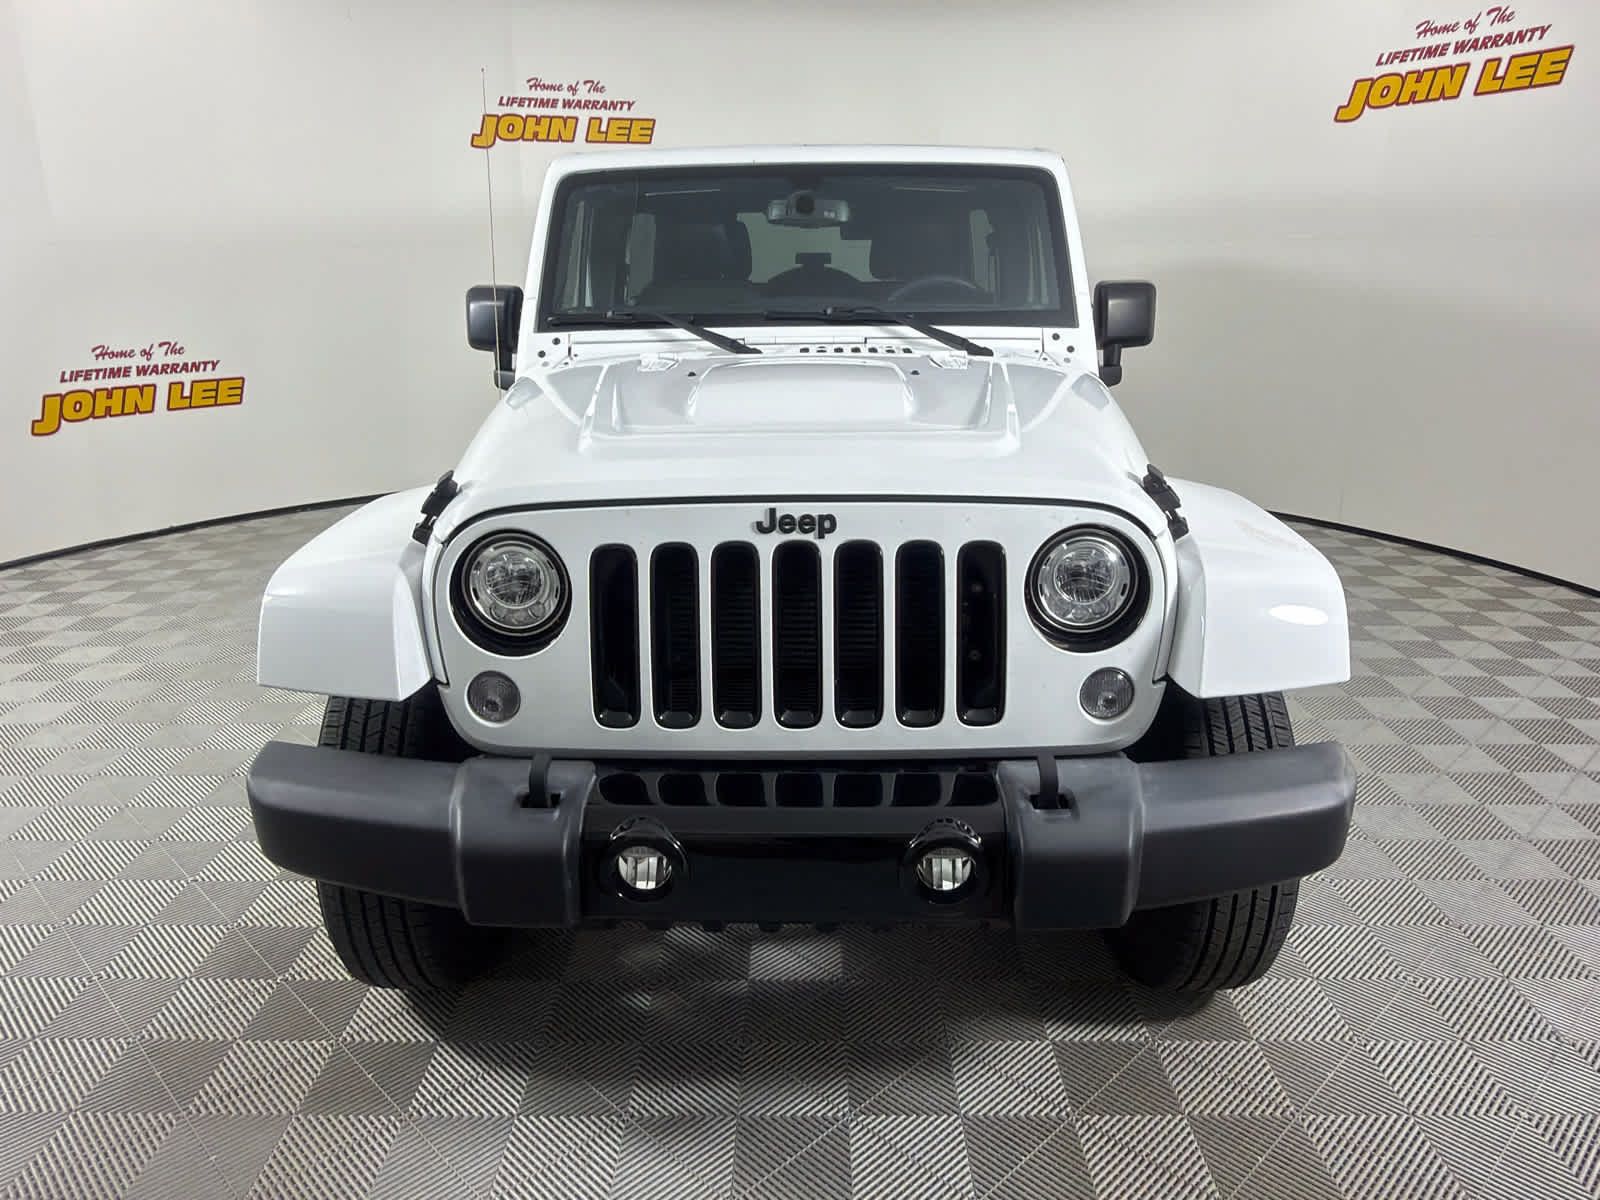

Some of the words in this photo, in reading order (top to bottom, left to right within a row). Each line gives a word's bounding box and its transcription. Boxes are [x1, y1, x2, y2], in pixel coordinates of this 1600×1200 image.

[1415, 19, 1460, 39] Home
[1463, 12, 1482, 35] of
[1486, 5, 1515, 24] The
[1375, 42, 1450, 66] LIFETIME
[1452, 24, 1552, 55] WARRANTY
[526, 77, 563, 92] Home
[567, 80, 579, 96] of
[583, 80, 606, 94] The
[1333, 62, 1471, 123] JOHN
[1473, 44, 1575, 96] LEE
[498, 96, 559, 109] LIFETIME
[561, 98, 636, 111] WARRANTY
[471, 113, 578, 149] JOHN
[585, 116, 656, 145] LEE
[91, 344, 136, 361] Home
[139, 344, 154, 361] of
[158, 341, 185, 356] The
[60, 366, 132, 383] LIFETIME
[135, 359, 220, 377] WARRANTY
[31, 383, 156, 436] JOHN
[166, 376, 245, 411] LEE
[755, 507, 837, 539] Jeep
